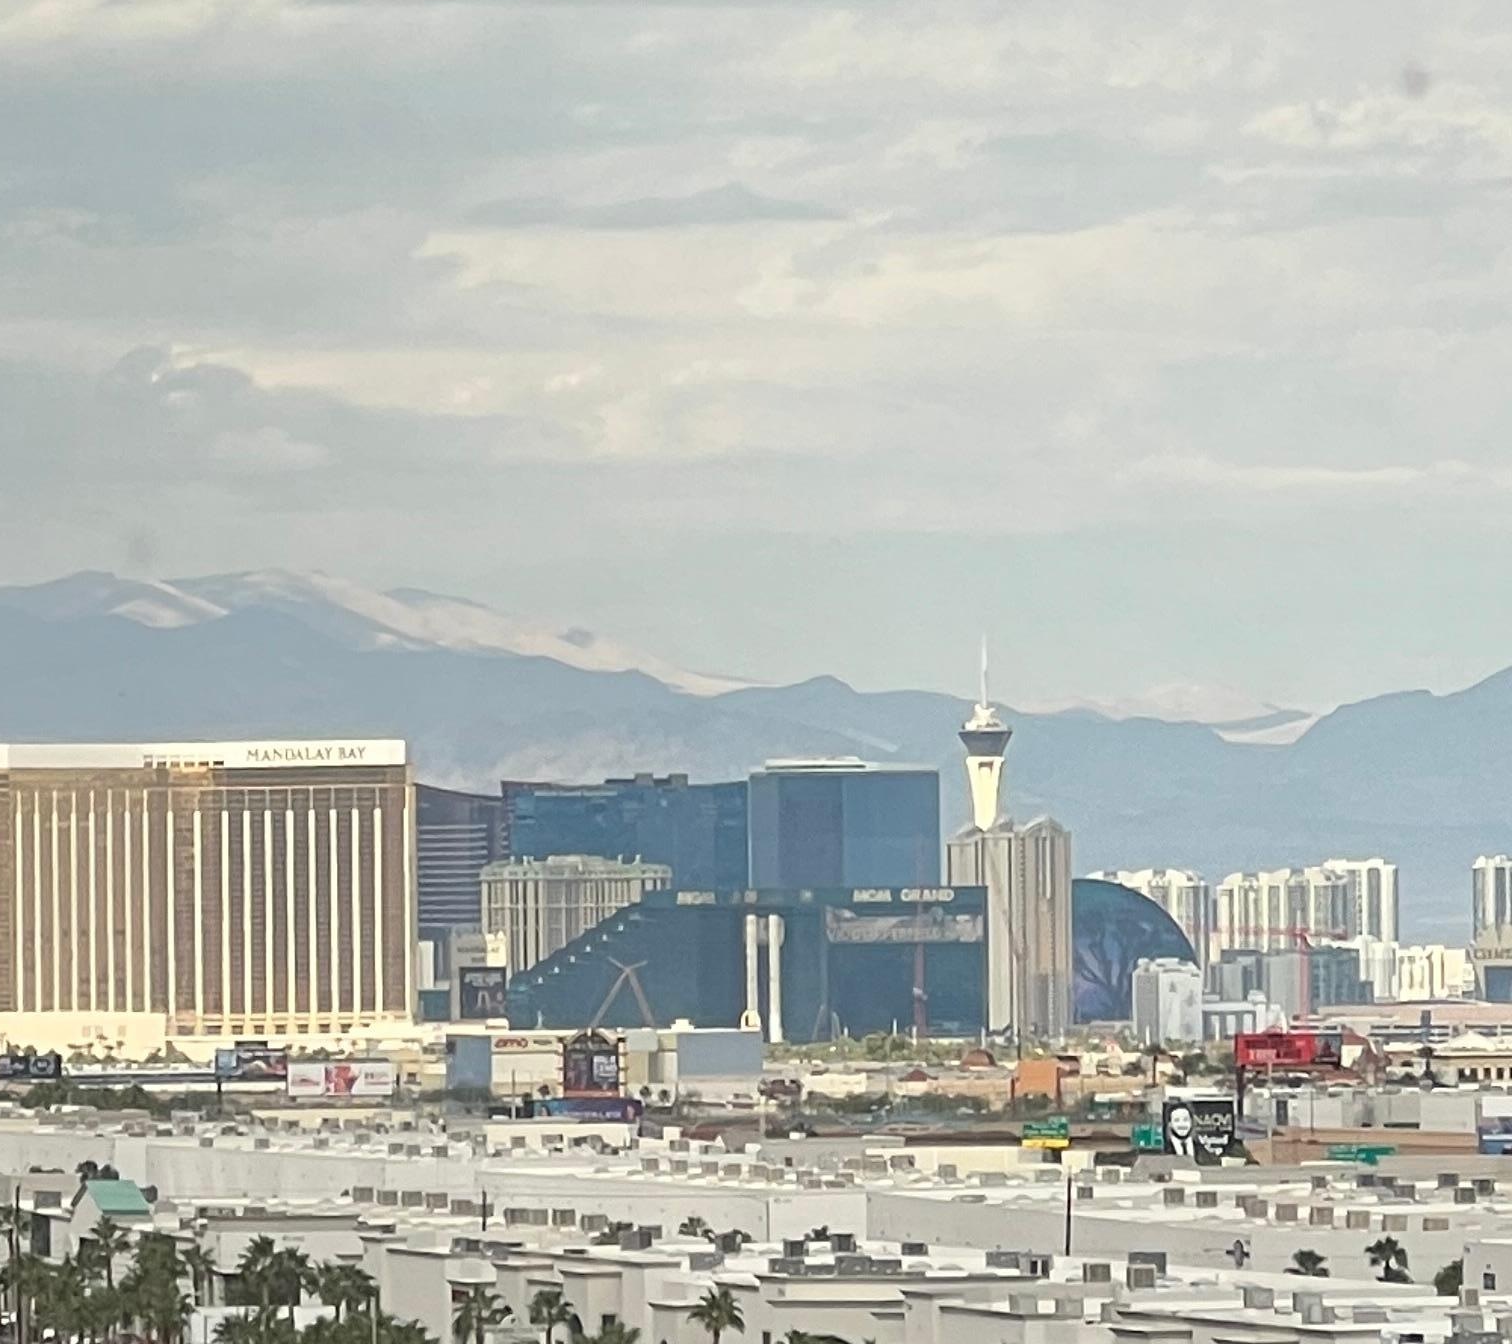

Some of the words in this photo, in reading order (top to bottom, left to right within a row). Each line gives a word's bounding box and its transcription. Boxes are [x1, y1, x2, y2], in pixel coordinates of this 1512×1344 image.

[247, 747, 332, 761] MANDALAY
[338, 746, 366, 760] BAY
[900, 889, 954, 902] GRAND
